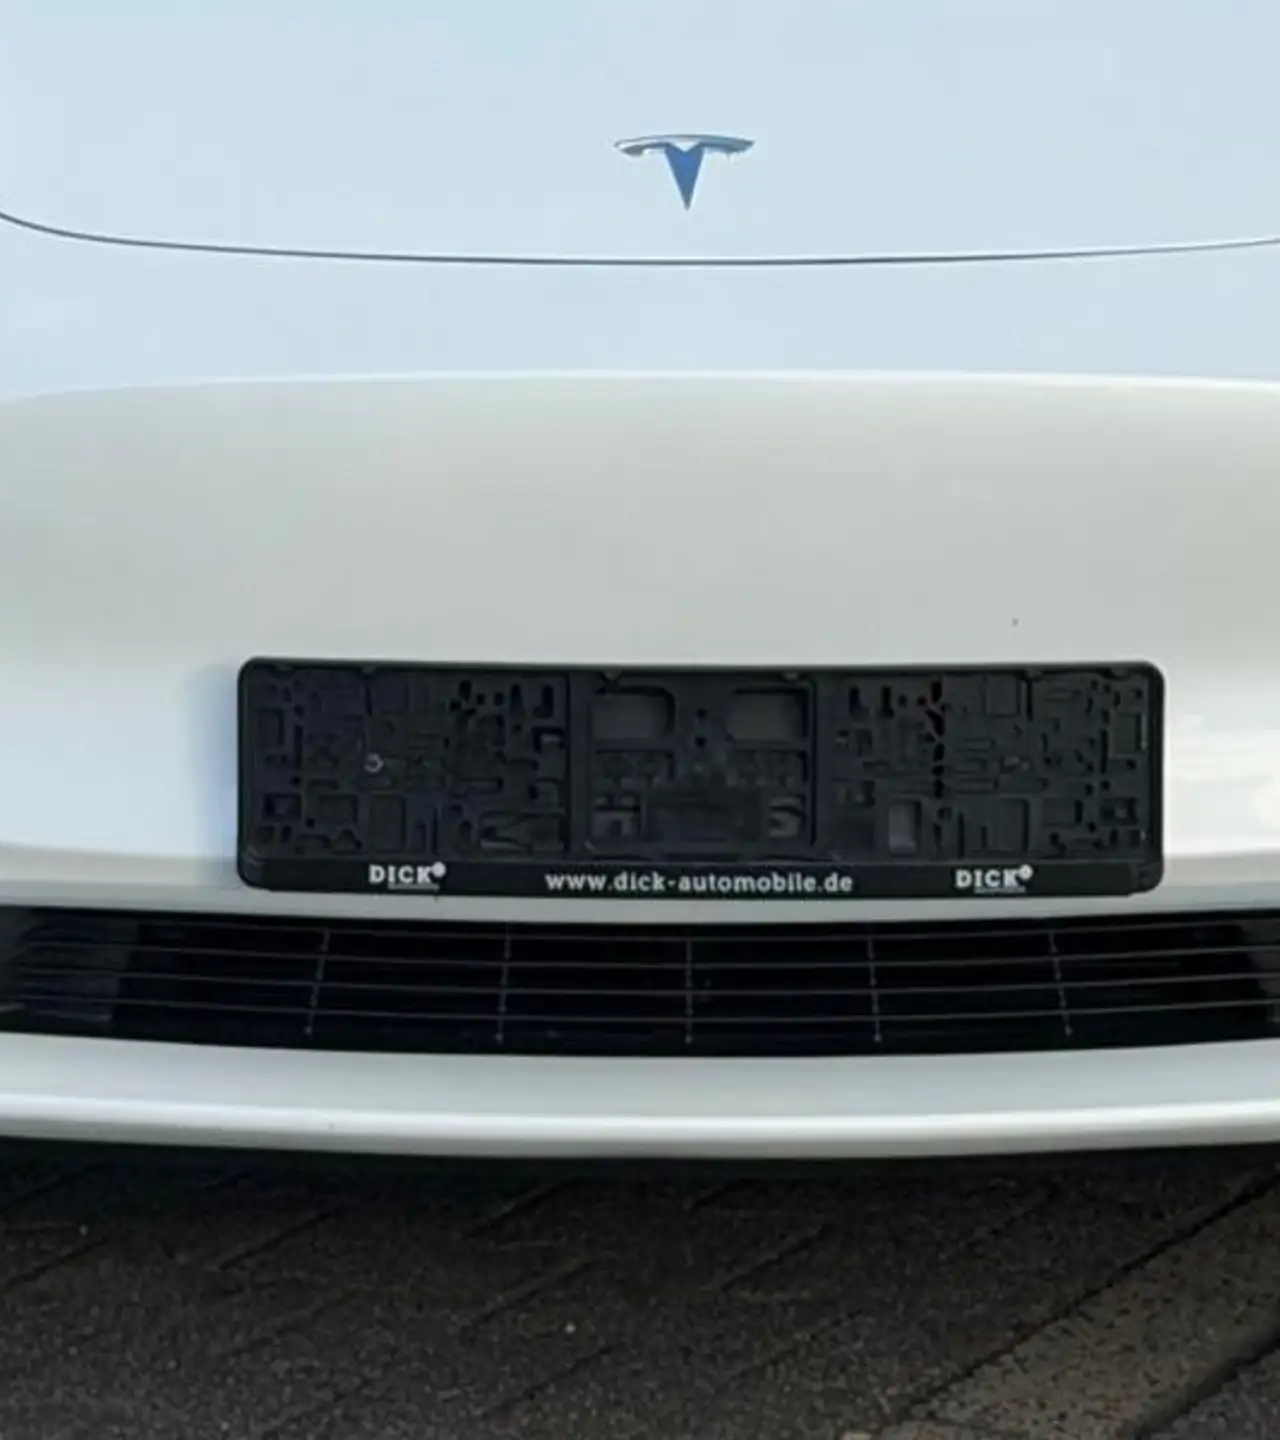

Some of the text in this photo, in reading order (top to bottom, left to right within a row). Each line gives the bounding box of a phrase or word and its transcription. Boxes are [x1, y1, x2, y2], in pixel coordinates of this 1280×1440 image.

[368, 864, 432, 884] DICK
[544, 871, 854, 893] www.dick-automobile.de
[954, 868, 1020, 889] DICK
